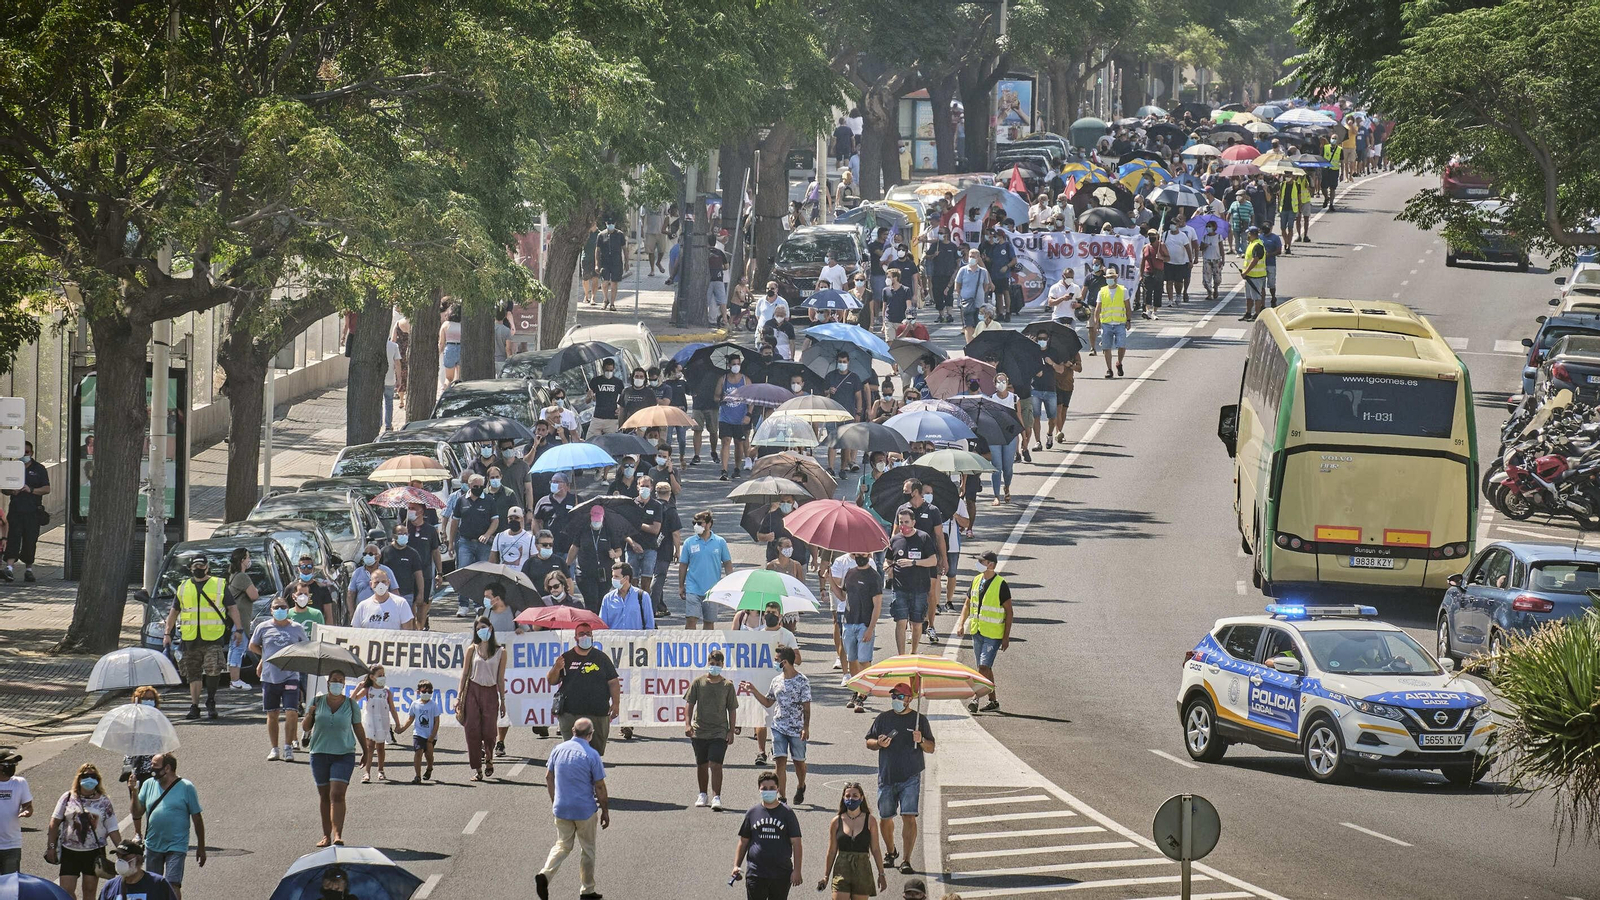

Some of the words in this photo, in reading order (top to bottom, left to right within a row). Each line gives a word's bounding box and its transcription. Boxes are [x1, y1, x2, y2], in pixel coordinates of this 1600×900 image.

[1010, 233, 1045, 252] QUÍ
[1047, 242, 1075, 259] NO
[1077, 241, 1137, 260] SOBRA
[1084, 262, 1136, 281] NDIE
[1023, 280, 1043, 288] CGT
[1342, 375, 1418, 387] www.tgcomes.es
[598, 384, 616, 392] VANS
[1363, 411, 1393, 422] M-031
[1454, 438, 1465, 446] 591
[1355, 557, 1375, 566] 9838
[1376, 559, 1392, 567] KZY
[366, 640, 464, 669] DEFENSA
[610, 646, 624, 669] y
[628, 642, 649, 667] la
[1251, 688, 1297, 713] POLICIA
[1251, 702, 1274, 716] LOCAL
[1425, 735, 1445, 745] 5655
[1447, 735, 1463, 745] KYZ
[753, 817, 785, 830] PASADENA
